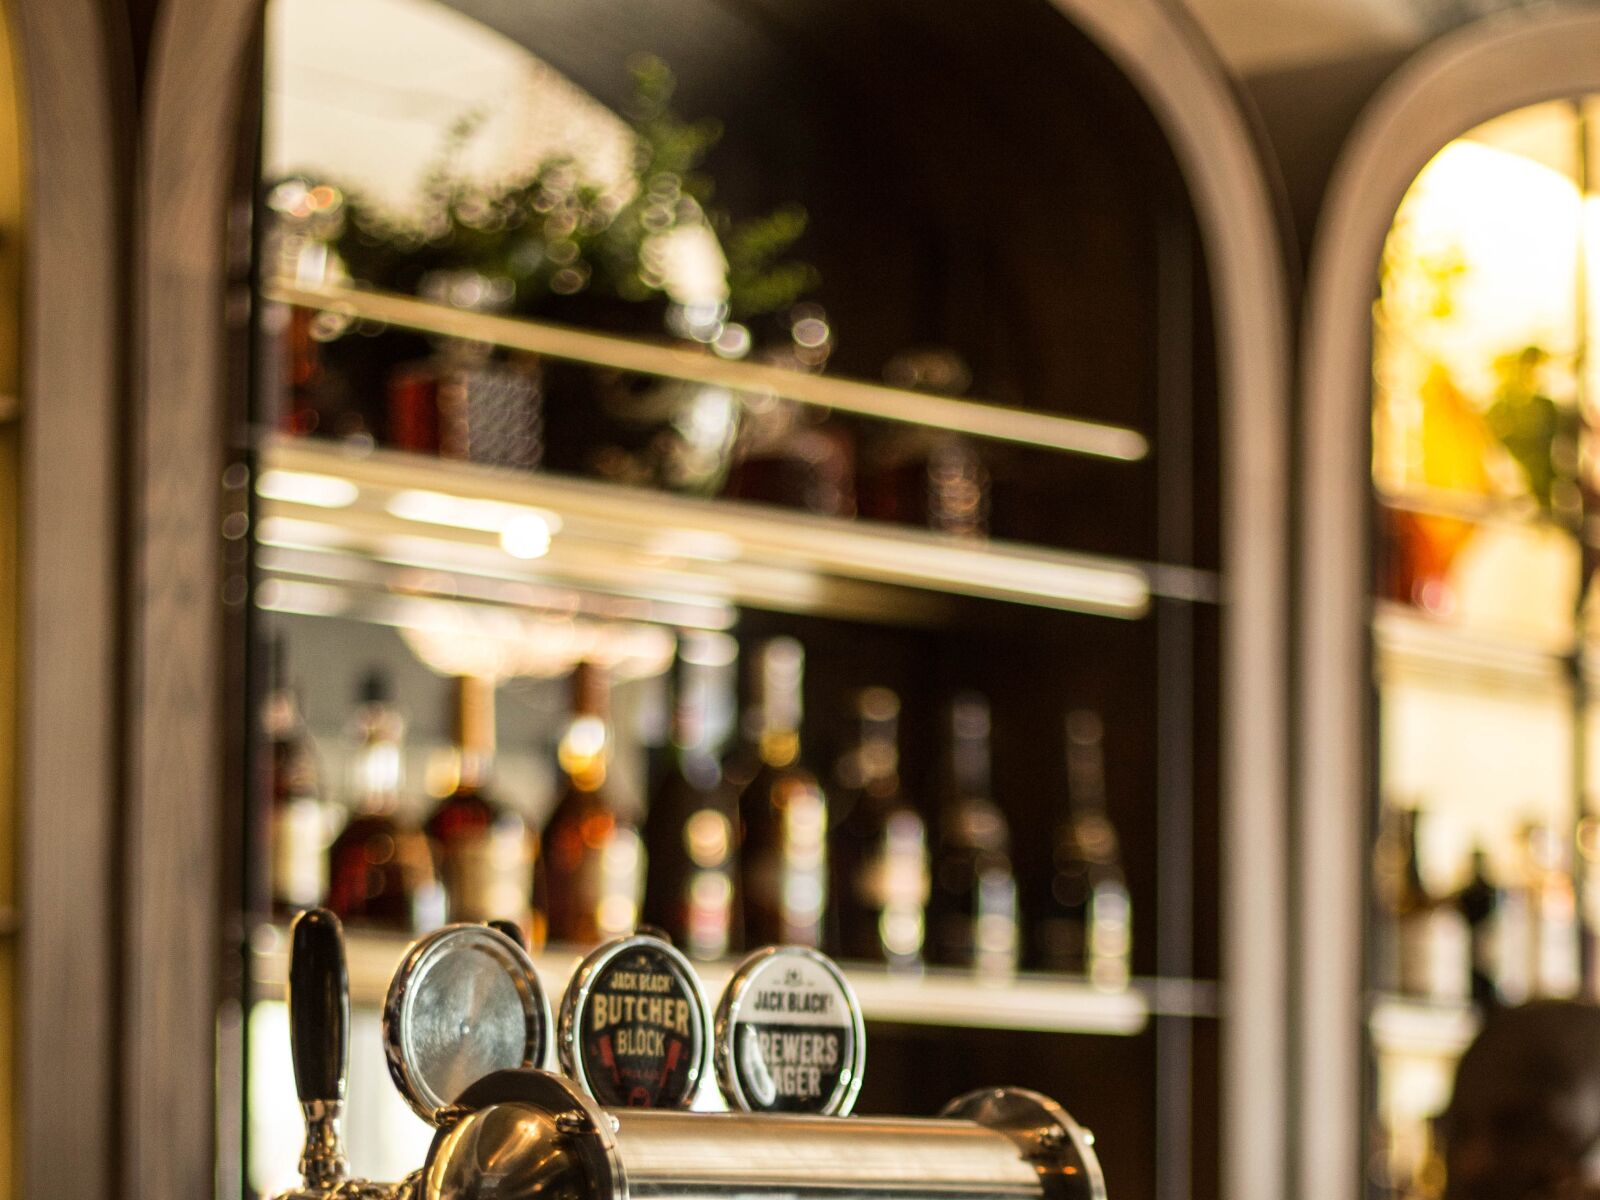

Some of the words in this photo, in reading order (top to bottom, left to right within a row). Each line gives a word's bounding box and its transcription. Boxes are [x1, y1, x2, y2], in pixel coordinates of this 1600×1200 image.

[611, 972, 637, 990] JACK
[593, 994, 688, 1036] BUTCHER
[754, 991, 784, 1011] JACK
[617, 1027, 665, 1056] BLOCK
[747, 1031, 838, 1066] REWERS
[763, 1065, 821, 1096] AGER
